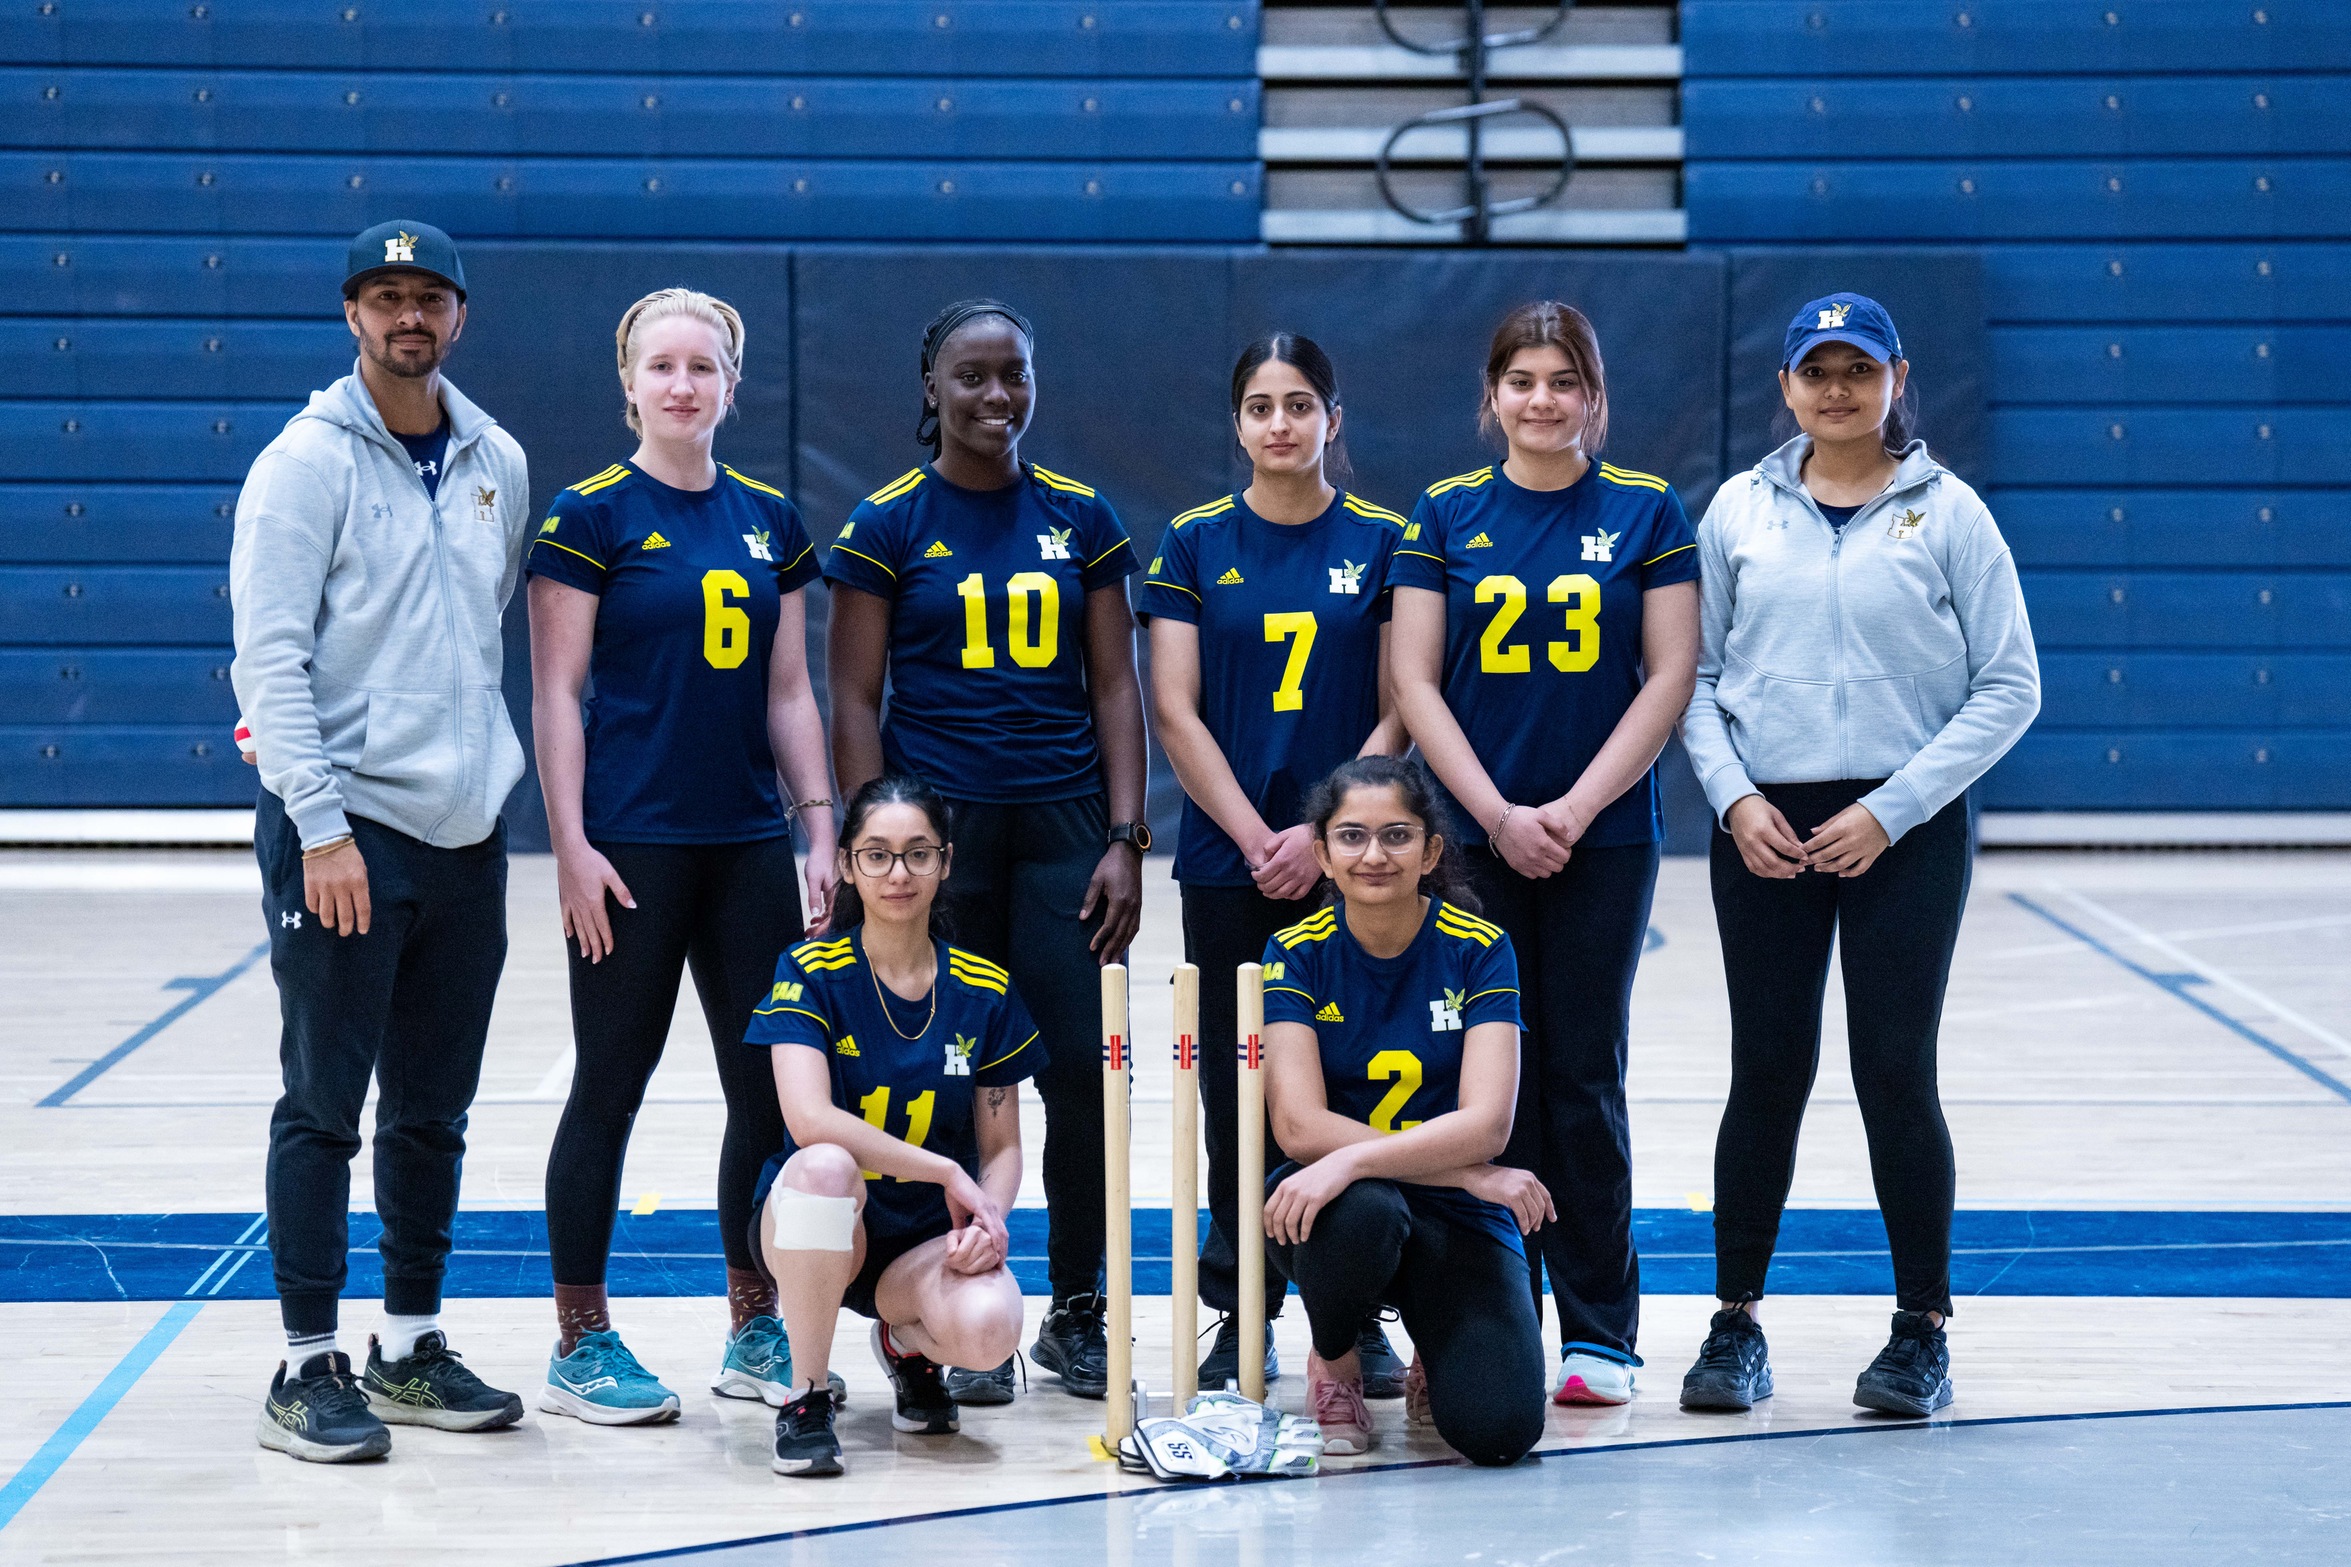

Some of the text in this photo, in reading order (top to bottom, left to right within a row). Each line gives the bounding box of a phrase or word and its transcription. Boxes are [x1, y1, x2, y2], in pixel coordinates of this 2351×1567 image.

[385, 238, 414, 262] H
[1817, 310, 1844, 329] H
[642, 540, 671, 550] adidas
[742, 534, 773, 562] H
[924, 550, 953, 559] adidas
[1037, 534, 1071, 560] H
[1465, 540, 1494, 549] adidas
[1581, 535, 1612, 562] H
[1216, 577, 1244, 585] adidas
[1328, 567, 1360, 595] H
[701, 569, 750, 670] 6
[957, 571, 1060, 669] 10
[1475, 573, 1602, 674] 23
[1264, 611, 1318, 712] 7
[1315, 1012, 1344, 1023] adidas
[1429, 998, 1463, 1032] H
[836, 1046, 861, 1057] adidas
[943, 1044, 971, 1076] H
[1367, 1050, 1423, 1135] 2
[859, 1085, 936, 1183] 11
